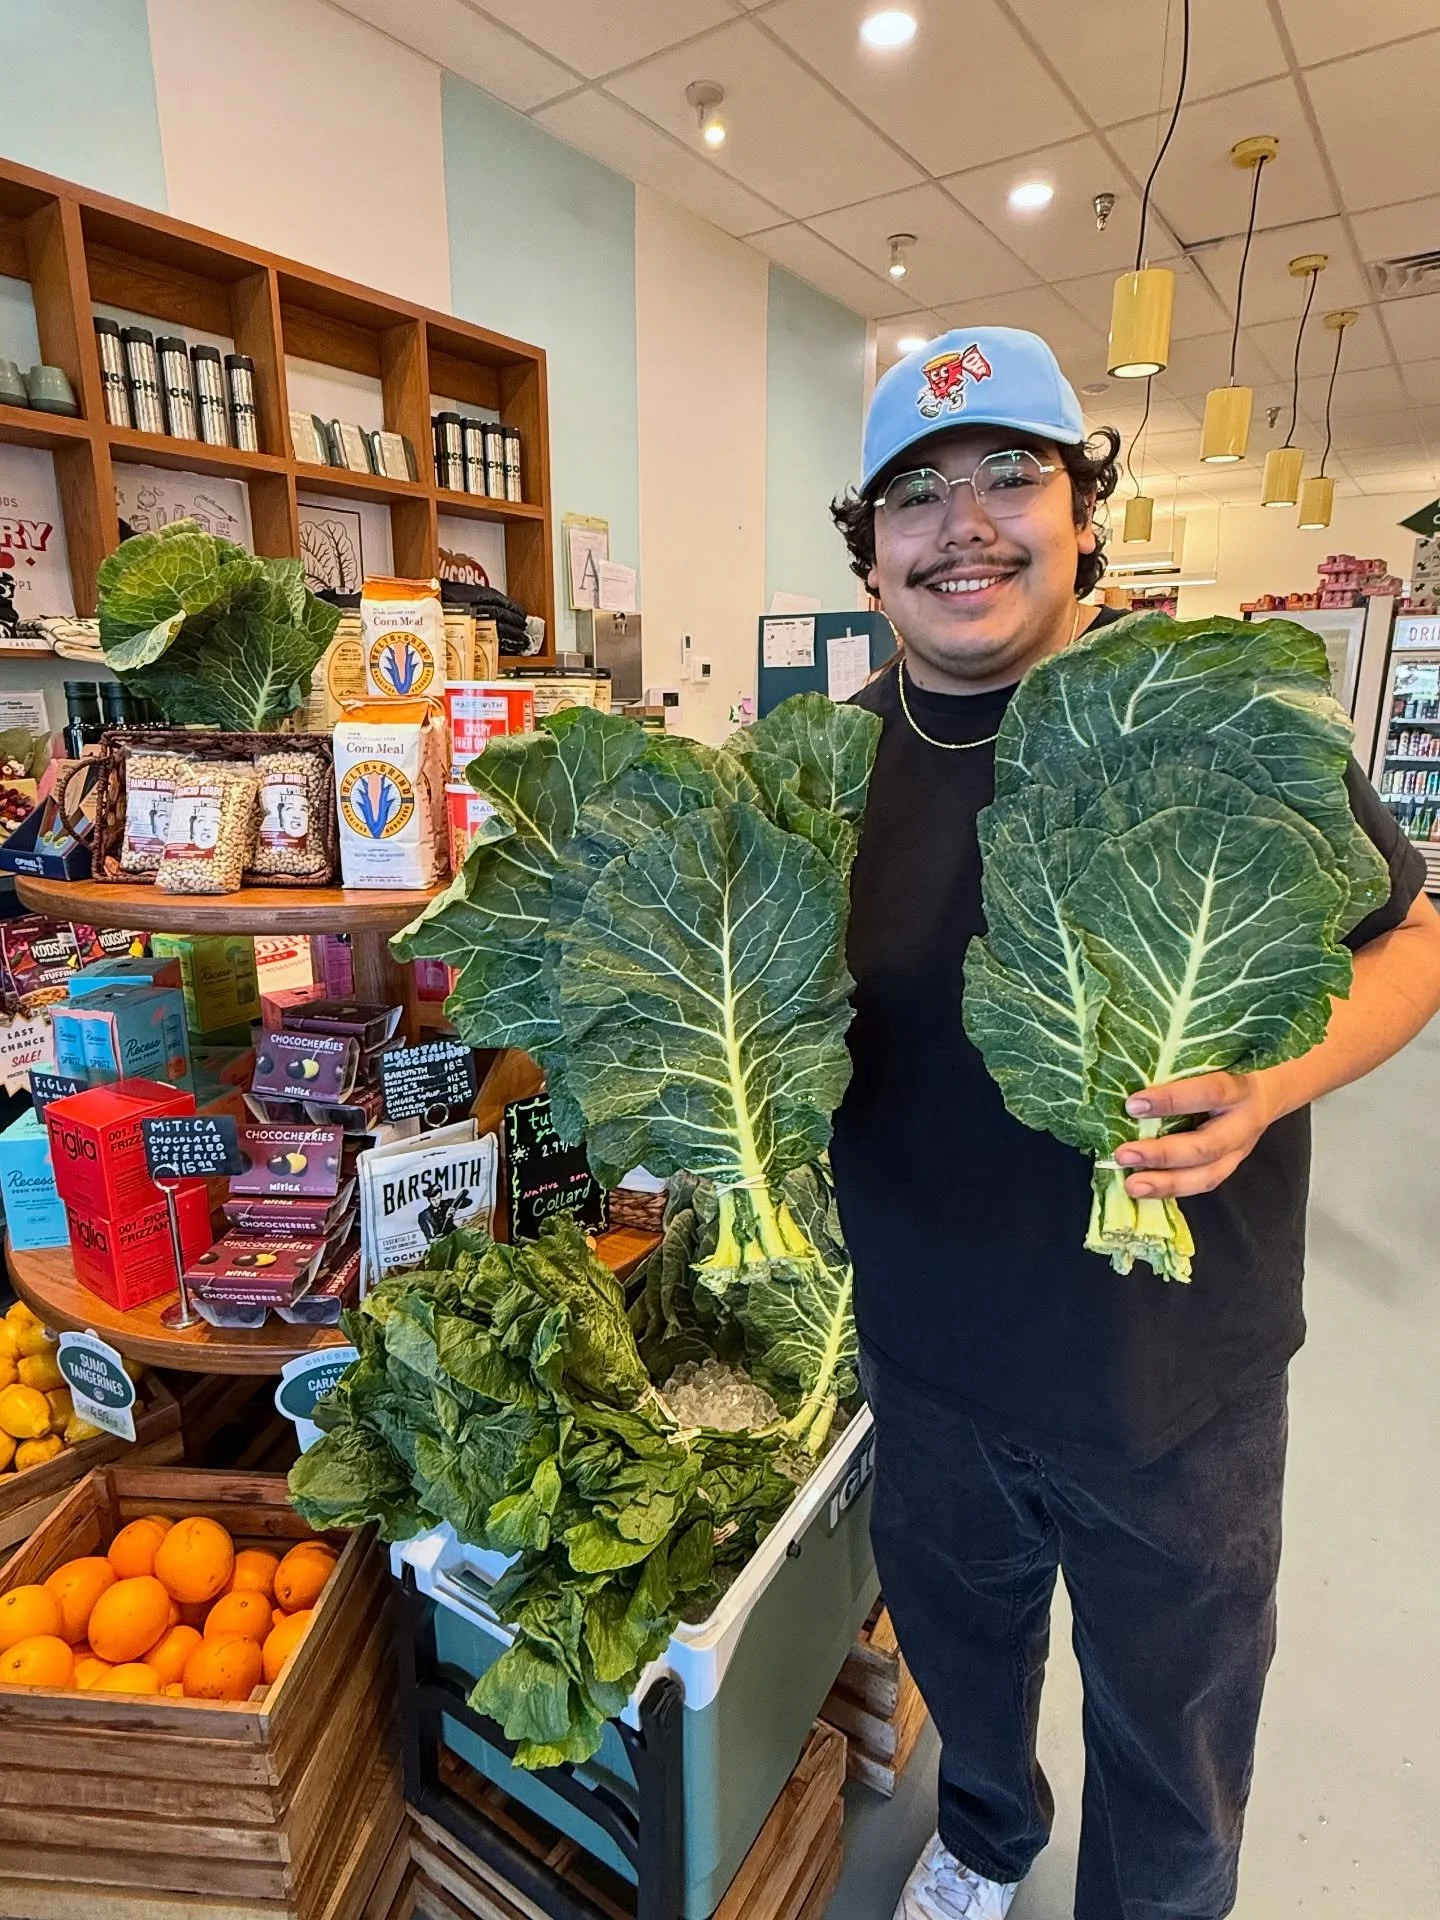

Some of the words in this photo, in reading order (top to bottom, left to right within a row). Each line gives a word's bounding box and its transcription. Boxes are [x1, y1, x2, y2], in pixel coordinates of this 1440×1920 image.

[0, 517, 54, 551] RY
[373, 616, 398, 626] Corn
[402, 616, 424, 626] Meal
[1408, 626, 1440, 642] DRI
[346, 742, 374, 754] Corn
[376, 743, 405, 755] Meal
[343, 764, 370, 794] DELTA
[379, 764, 411, 796] GRIND
[7, 1027, 34, 1040] LAST
[1, 1036, 46, 1053] CHANCE
[125, 1038, 162, 1058] Recess
[270, 1033, 345, 1052] CHOCOCHERRIES
[12, 1050, 42, 1067] SALE!
[384, 1066, 428, 1081] BARSMITH
[528, 1111, 553, 1130] tu
[49, 1117, 98, 1162] Figlia
[149, 1134, 221, 1145] CHOCOLATE
[245, 1129, 335, 1142] CHOCOCHERRIES
[151, 1143, 225, 1154] COVERED
[152, 1152, 227, 1162] CHERRIES
[8, 1170, 56, 1188] Recess
[383, 1157, 482, 1217] BARSMITH
[532, 1178, 591, 1217] Collard
[143, 1209, 169, 1226] FIOR
[240, 1220, 318, 1231] CHOCOCHERRIES
[120, 1219, 168, 1246] FRIZZAN
[223, 1240, 314, 1250] CHOCOCHERRIES
[202, 1292, 283, 1302] CHOCOCHERRIES
[80, 1353, 108, 1377] SUMO
[68, 1362, 125, 1398] TANGERINES
